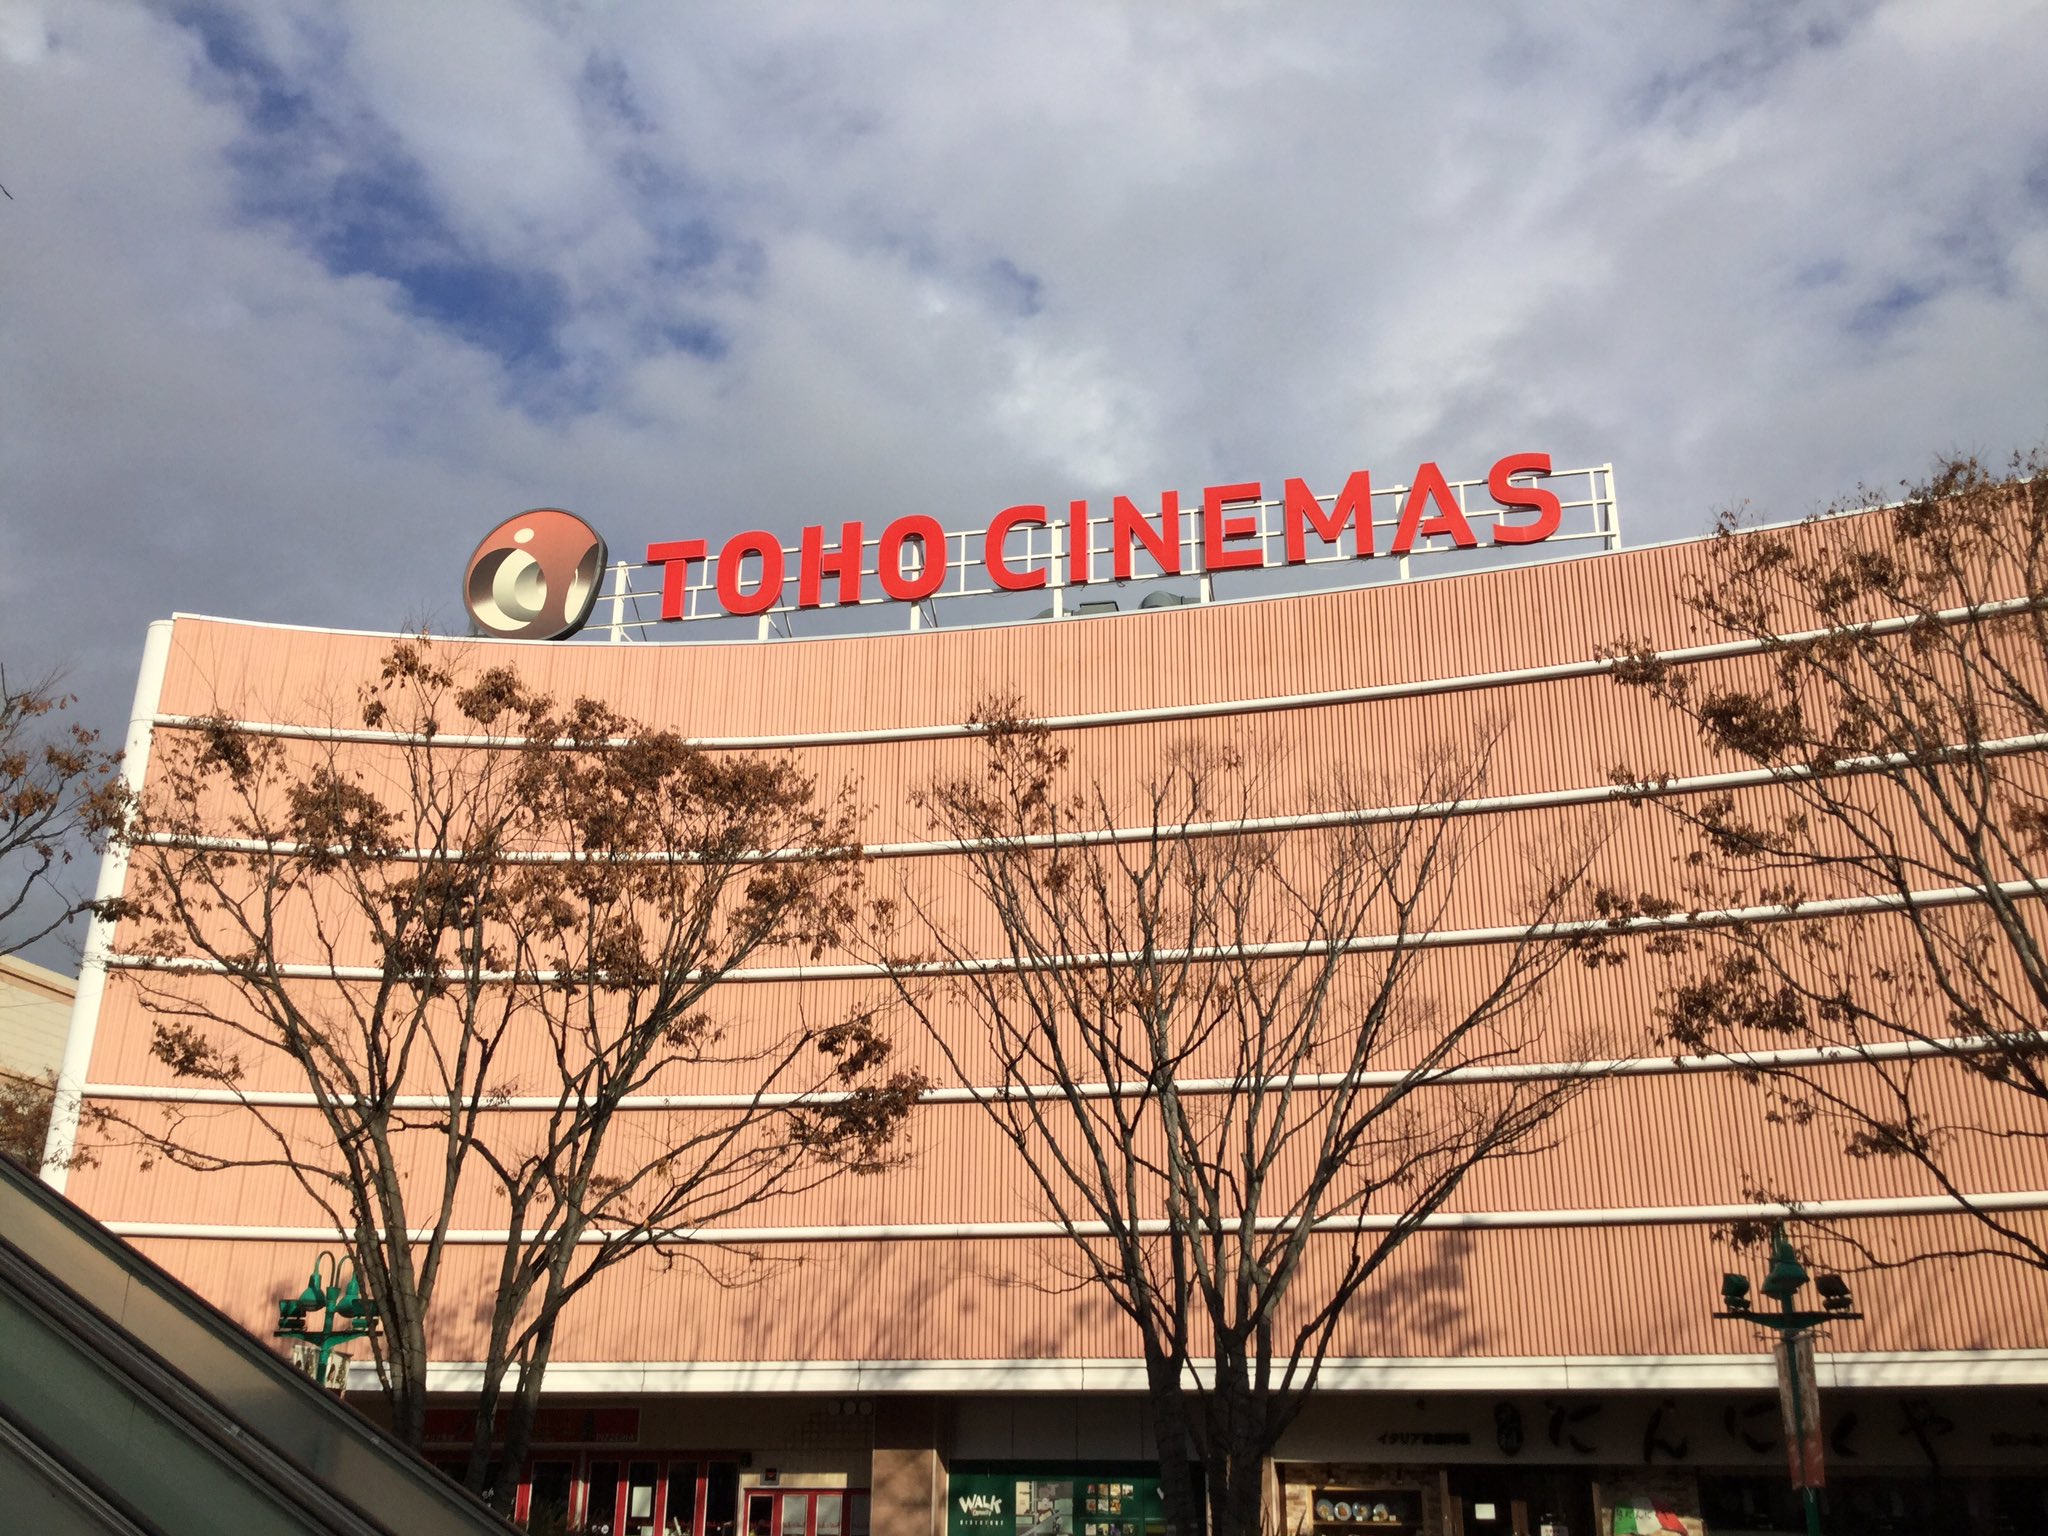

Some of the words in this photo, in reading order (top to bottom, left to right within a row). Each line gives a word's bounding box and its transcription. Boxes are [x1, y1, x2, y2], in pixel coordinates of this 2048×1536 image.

[646, 512, 948, 621] TOHO
[984, 452, 1562, 591] CINEMAS
[959, 1494, 1003, 1515] WALK
